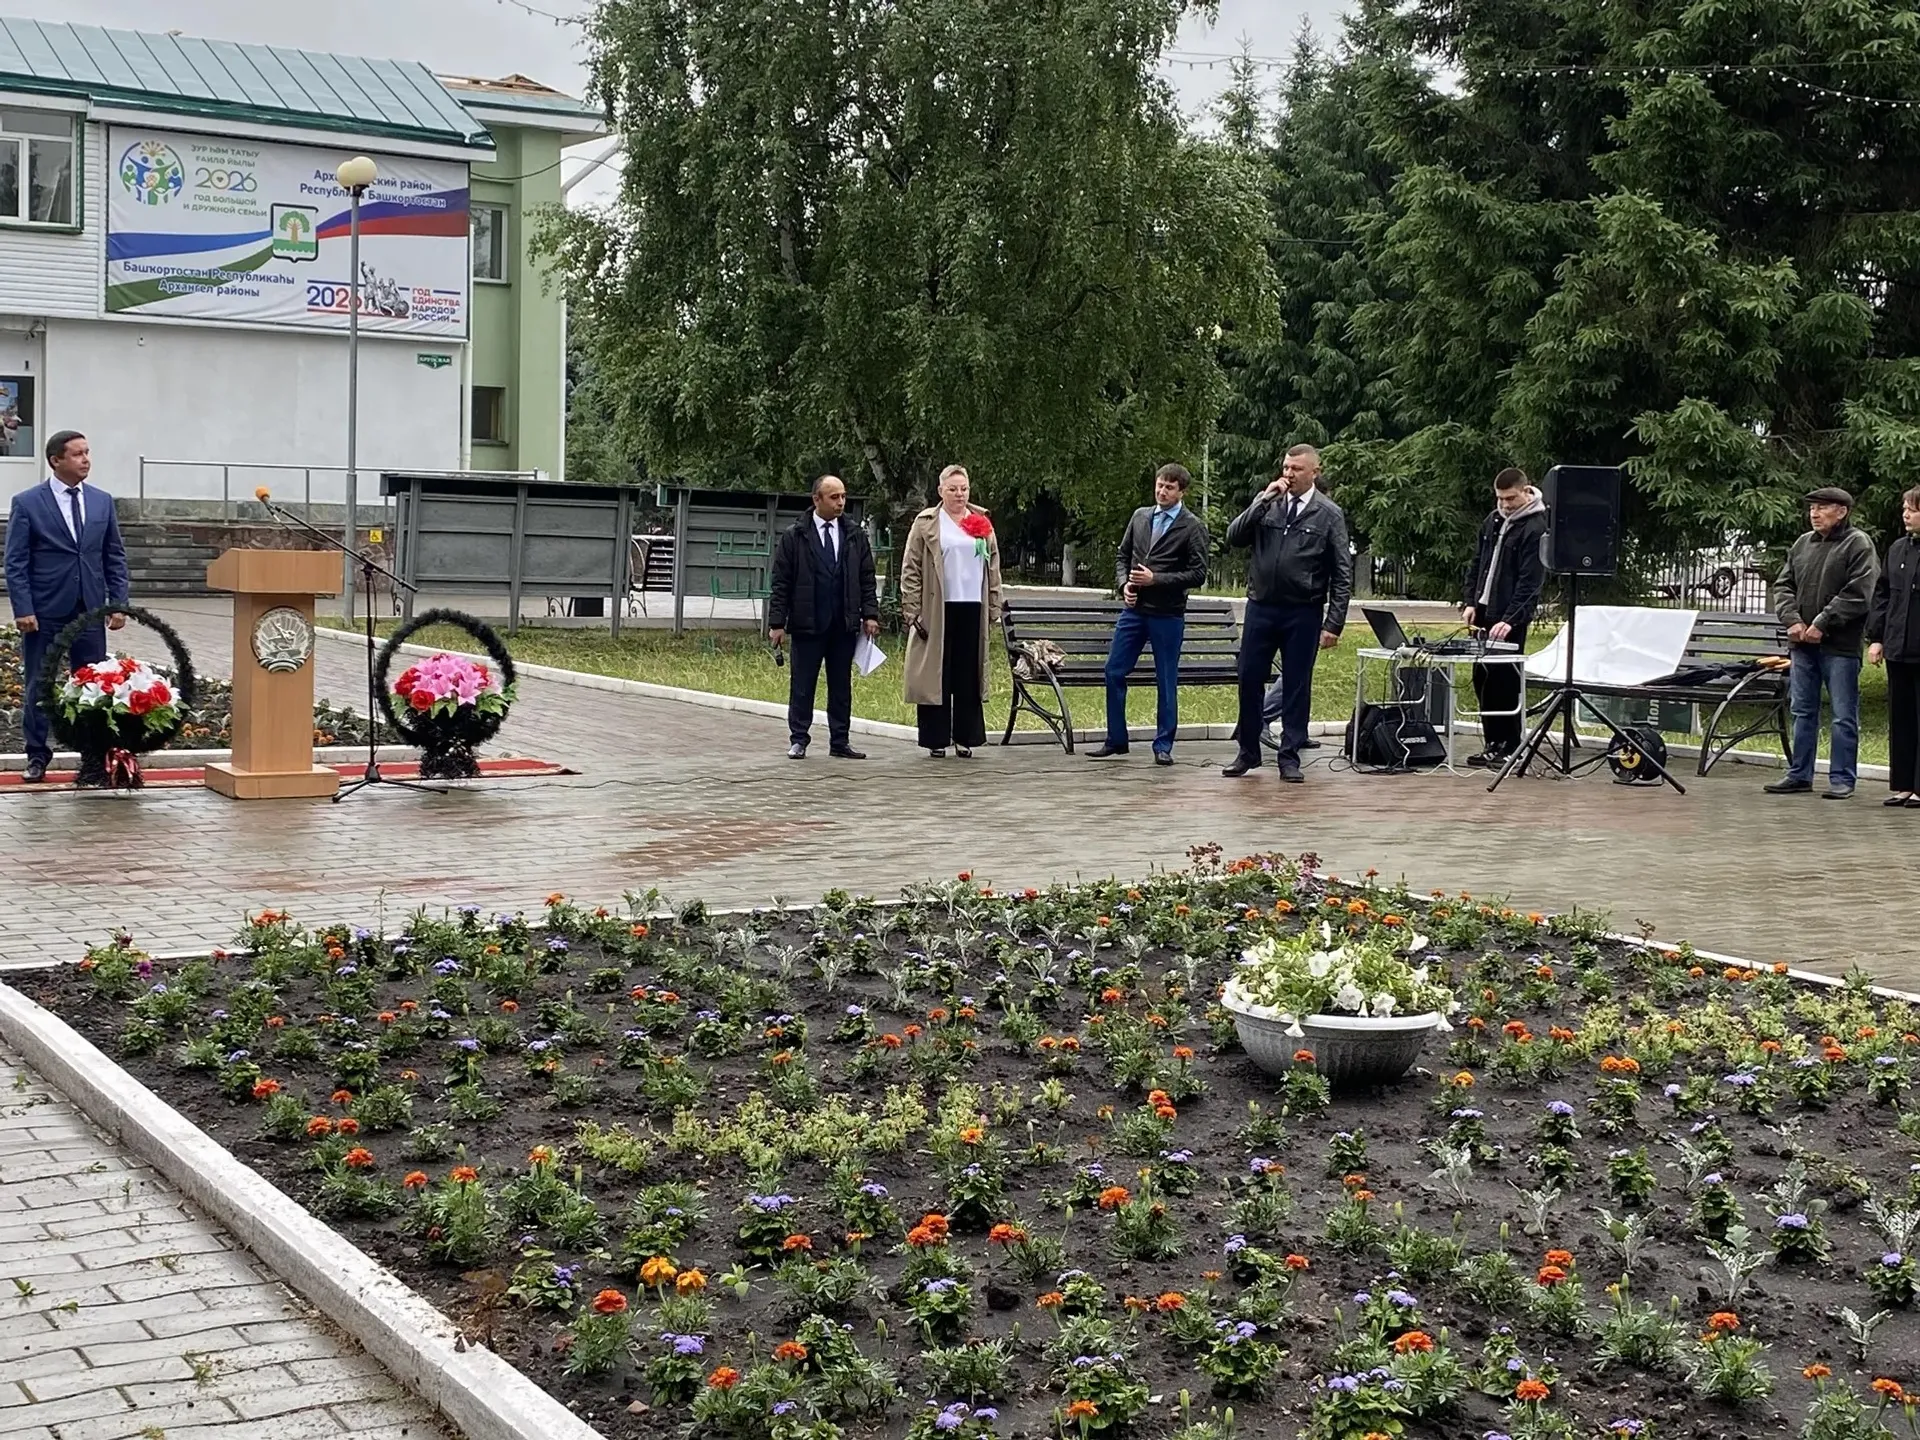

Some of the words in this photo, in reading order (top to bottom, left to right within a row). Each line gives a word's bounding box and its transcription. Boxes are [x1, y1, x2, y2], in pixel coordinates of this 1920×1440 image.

[230, 149, 260, 158] ТАТЫУ
[194, 167, 258, 192] 2026
[400, 178, 432, 191] район
[194, 194, 211, 203] ГОД
[212, 196, 257, 206] БОЛЬШОЙ
[368, 190, 446, 208] Башкортостан
[192, 204, 236, 214] ДРУЖНОЙ
[238, 208, 268, 217] СЕМЬИ
[160, 279, 213, 293] Архангел
[217, 285, 260, 297] районы
[412, 288, 431, 296] ГОД
[412, 297, 460, 306] ЕДИНСТВА
[412, 306, 456, 314] НАРОДОВ
[412, 314, 450, 322] РОССИИ
